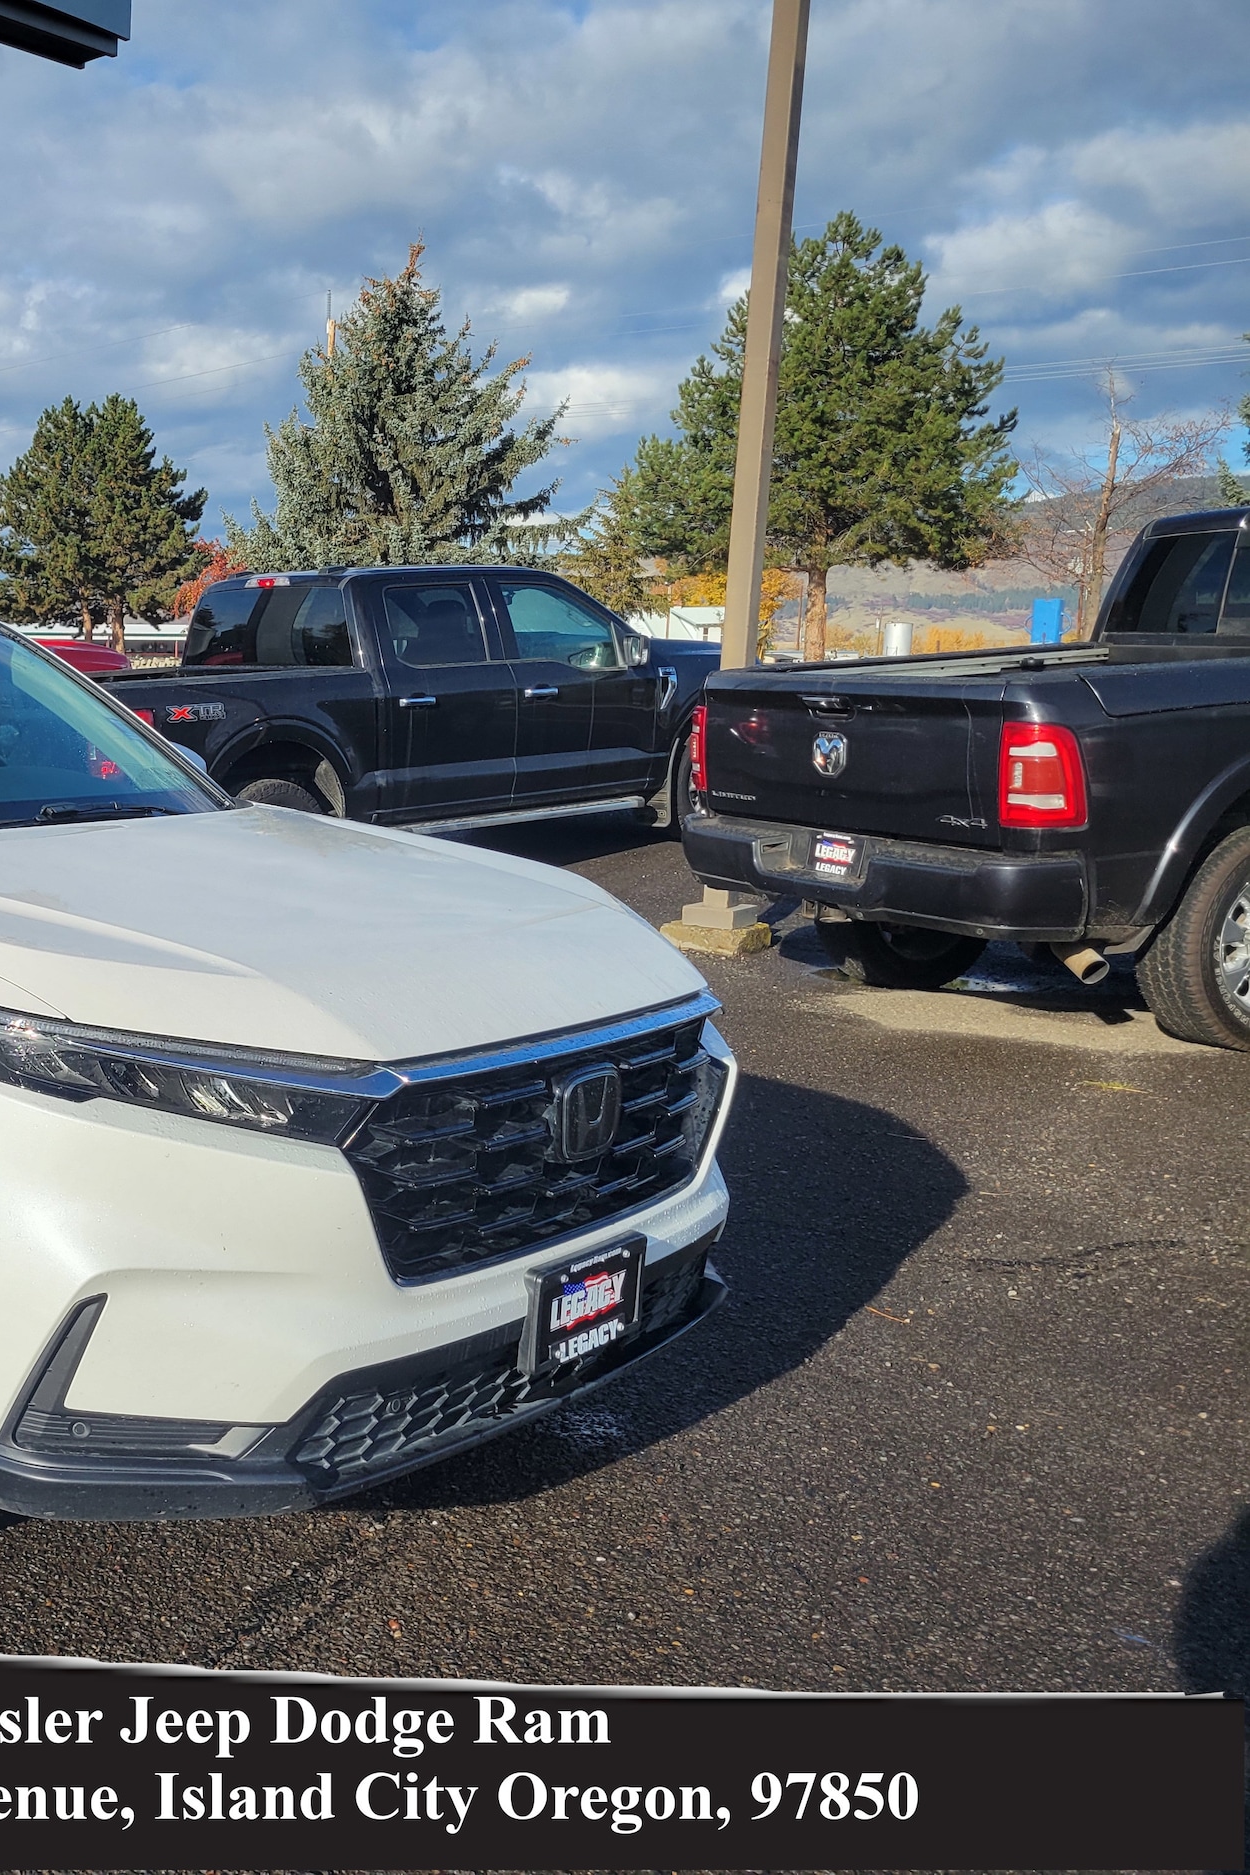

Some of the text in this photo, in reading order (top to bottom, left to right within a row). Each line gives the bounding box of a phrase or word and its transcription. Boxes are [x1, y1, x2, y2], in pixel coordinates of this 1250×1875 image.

[815, 843, 856, 862] LEGACY
[815, 862, 847, 875] LEGACY
[550, 1272, 626, 1329] LEGACY
[559, 1319, 619, 1363] LEGACY
